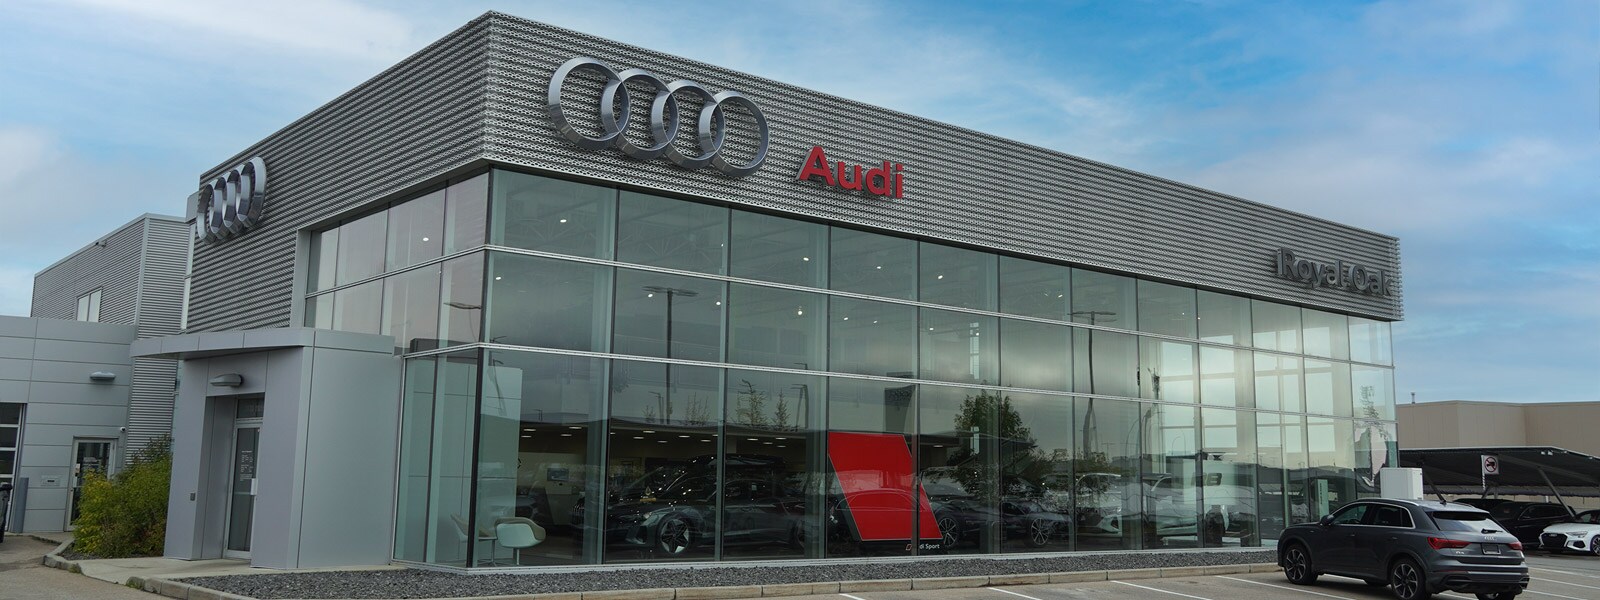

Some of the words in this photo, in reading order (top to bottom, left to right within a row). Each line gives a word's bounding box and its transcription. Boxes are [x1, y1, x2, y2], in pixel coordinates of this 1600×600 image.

[797, 145, 903, 199] Audi
[1277, 246, 1343, 288] Royal
[1349, 263, 1392, 296] Oak
